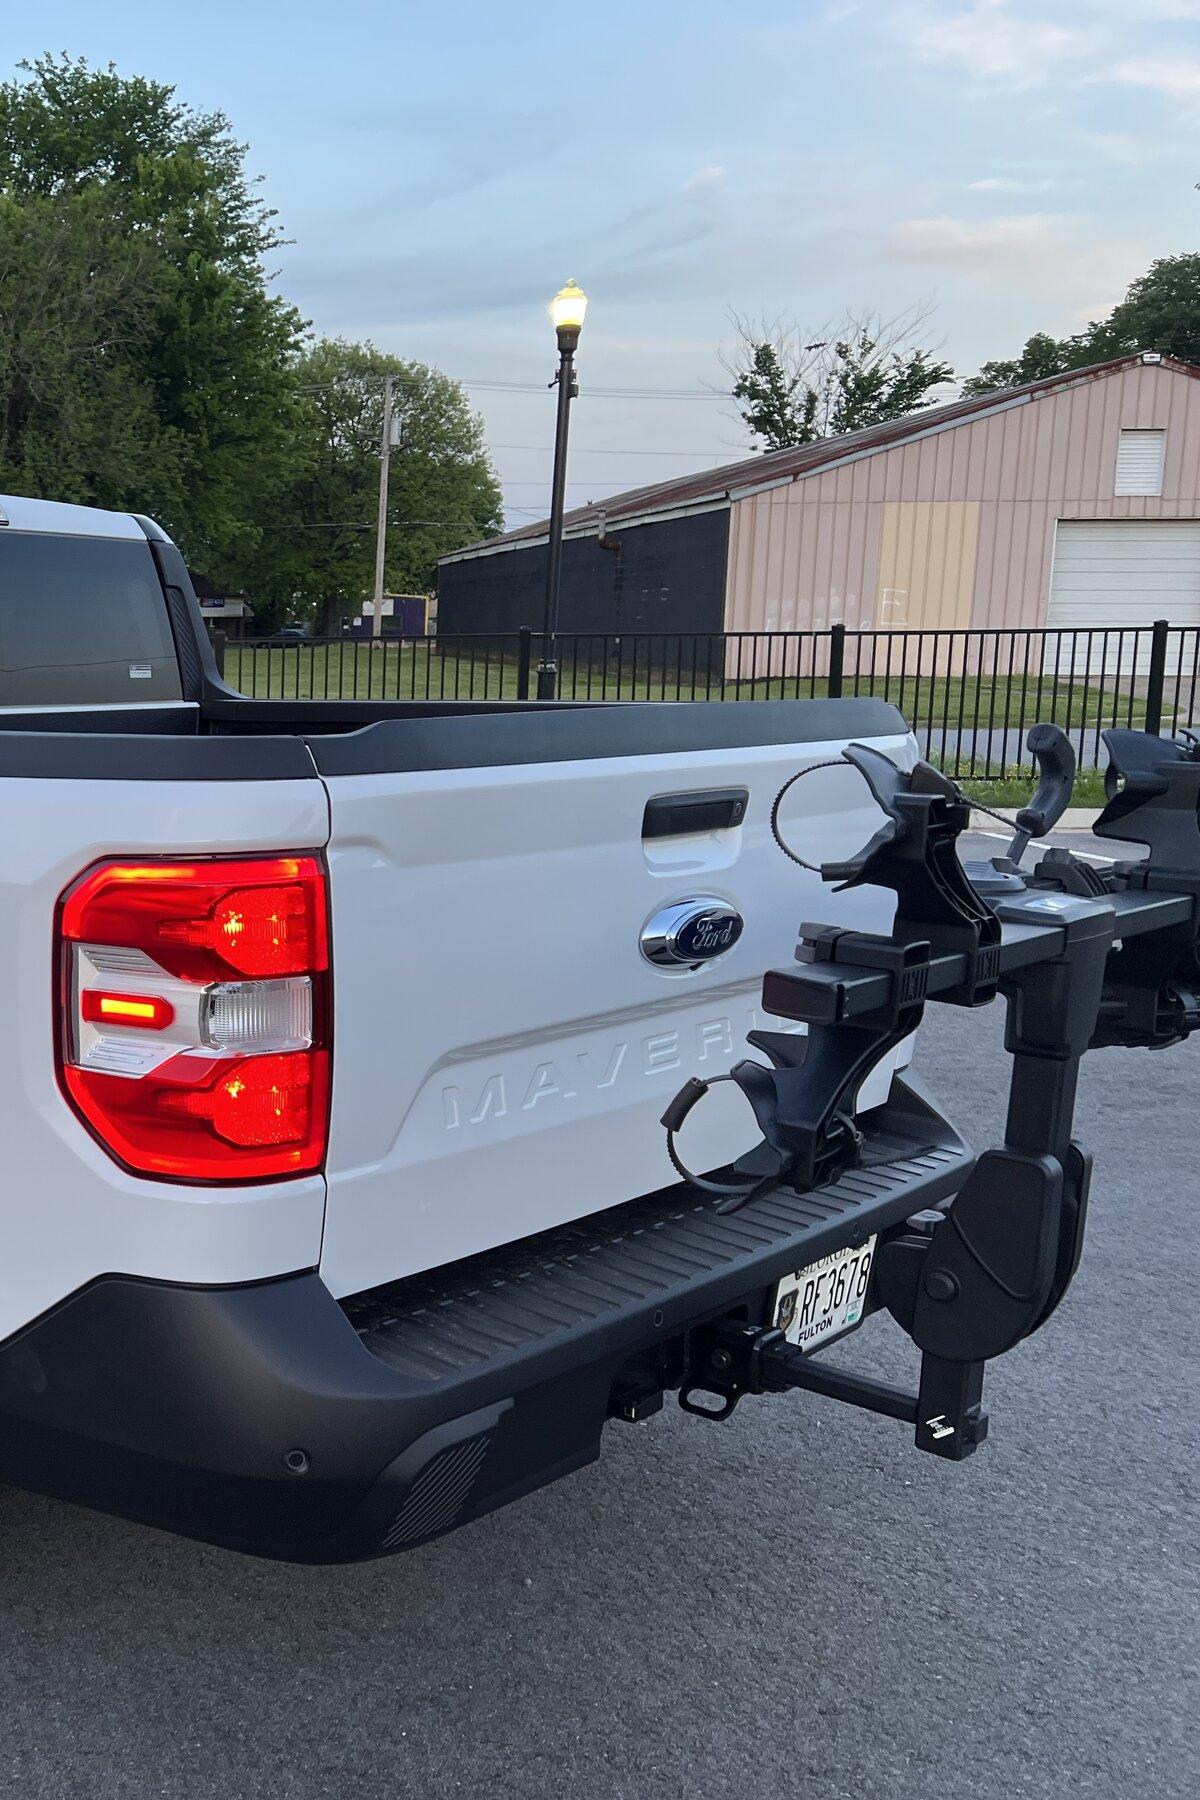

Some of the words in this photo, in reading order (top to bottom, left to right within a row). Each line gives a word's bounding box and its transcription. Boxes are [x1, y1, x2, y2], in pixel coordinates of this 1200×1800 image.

[692, 917, 734, 951] Ford
[798, 1252, 872, 1330] RF3678
[798, 1315, 834, 1345] FULTON
